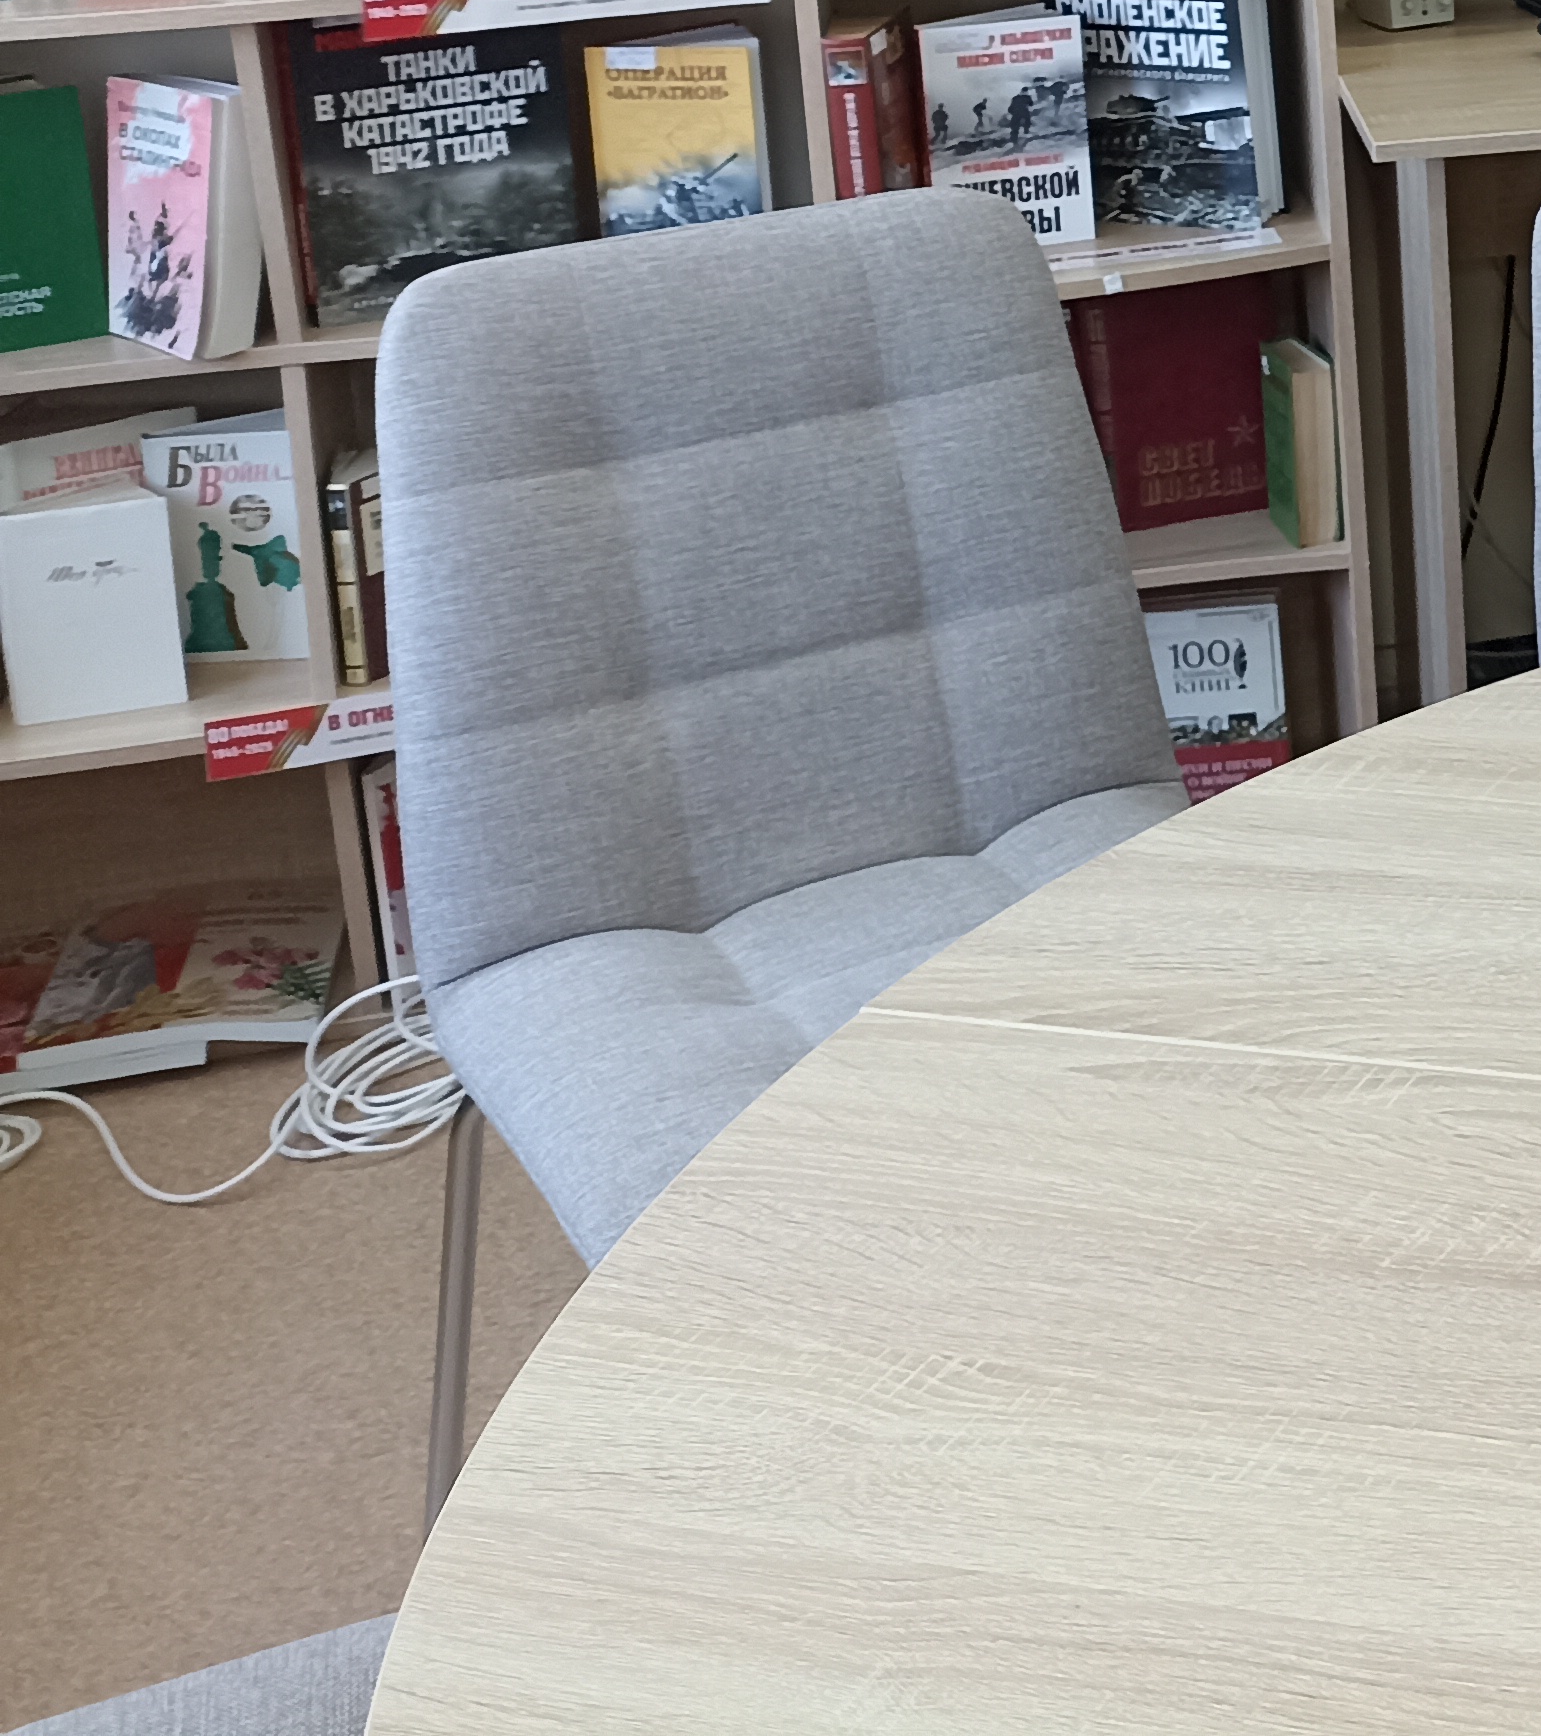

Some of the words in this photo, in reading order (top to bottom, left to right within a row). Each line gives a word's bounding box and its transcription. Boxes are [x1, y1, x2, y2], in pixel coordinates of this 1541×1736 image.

[380, 45, 477, 83] ТАНКИ
[1083, 29, 1232, 70] РАЖЕНИЕ
[314, 93, 336, 123] В
[341, 60, 548, 119] ХАРЬКОВСКОЙ
[605, 65, 728, 82] ОПЕРАЦИЯ
[341, 99, 529, 149] КАТАСТРОФЕ
[366, 149, 432, 176] 1942
[437, 130, 511, 167] ГОДА
[952, 165, 1080, 203] ЕВСКОЙ
[1170, 639, 1231, 670] 100
[327, 714, 341, 731] В
[348, 705, 394, 727] ОГНЕ
